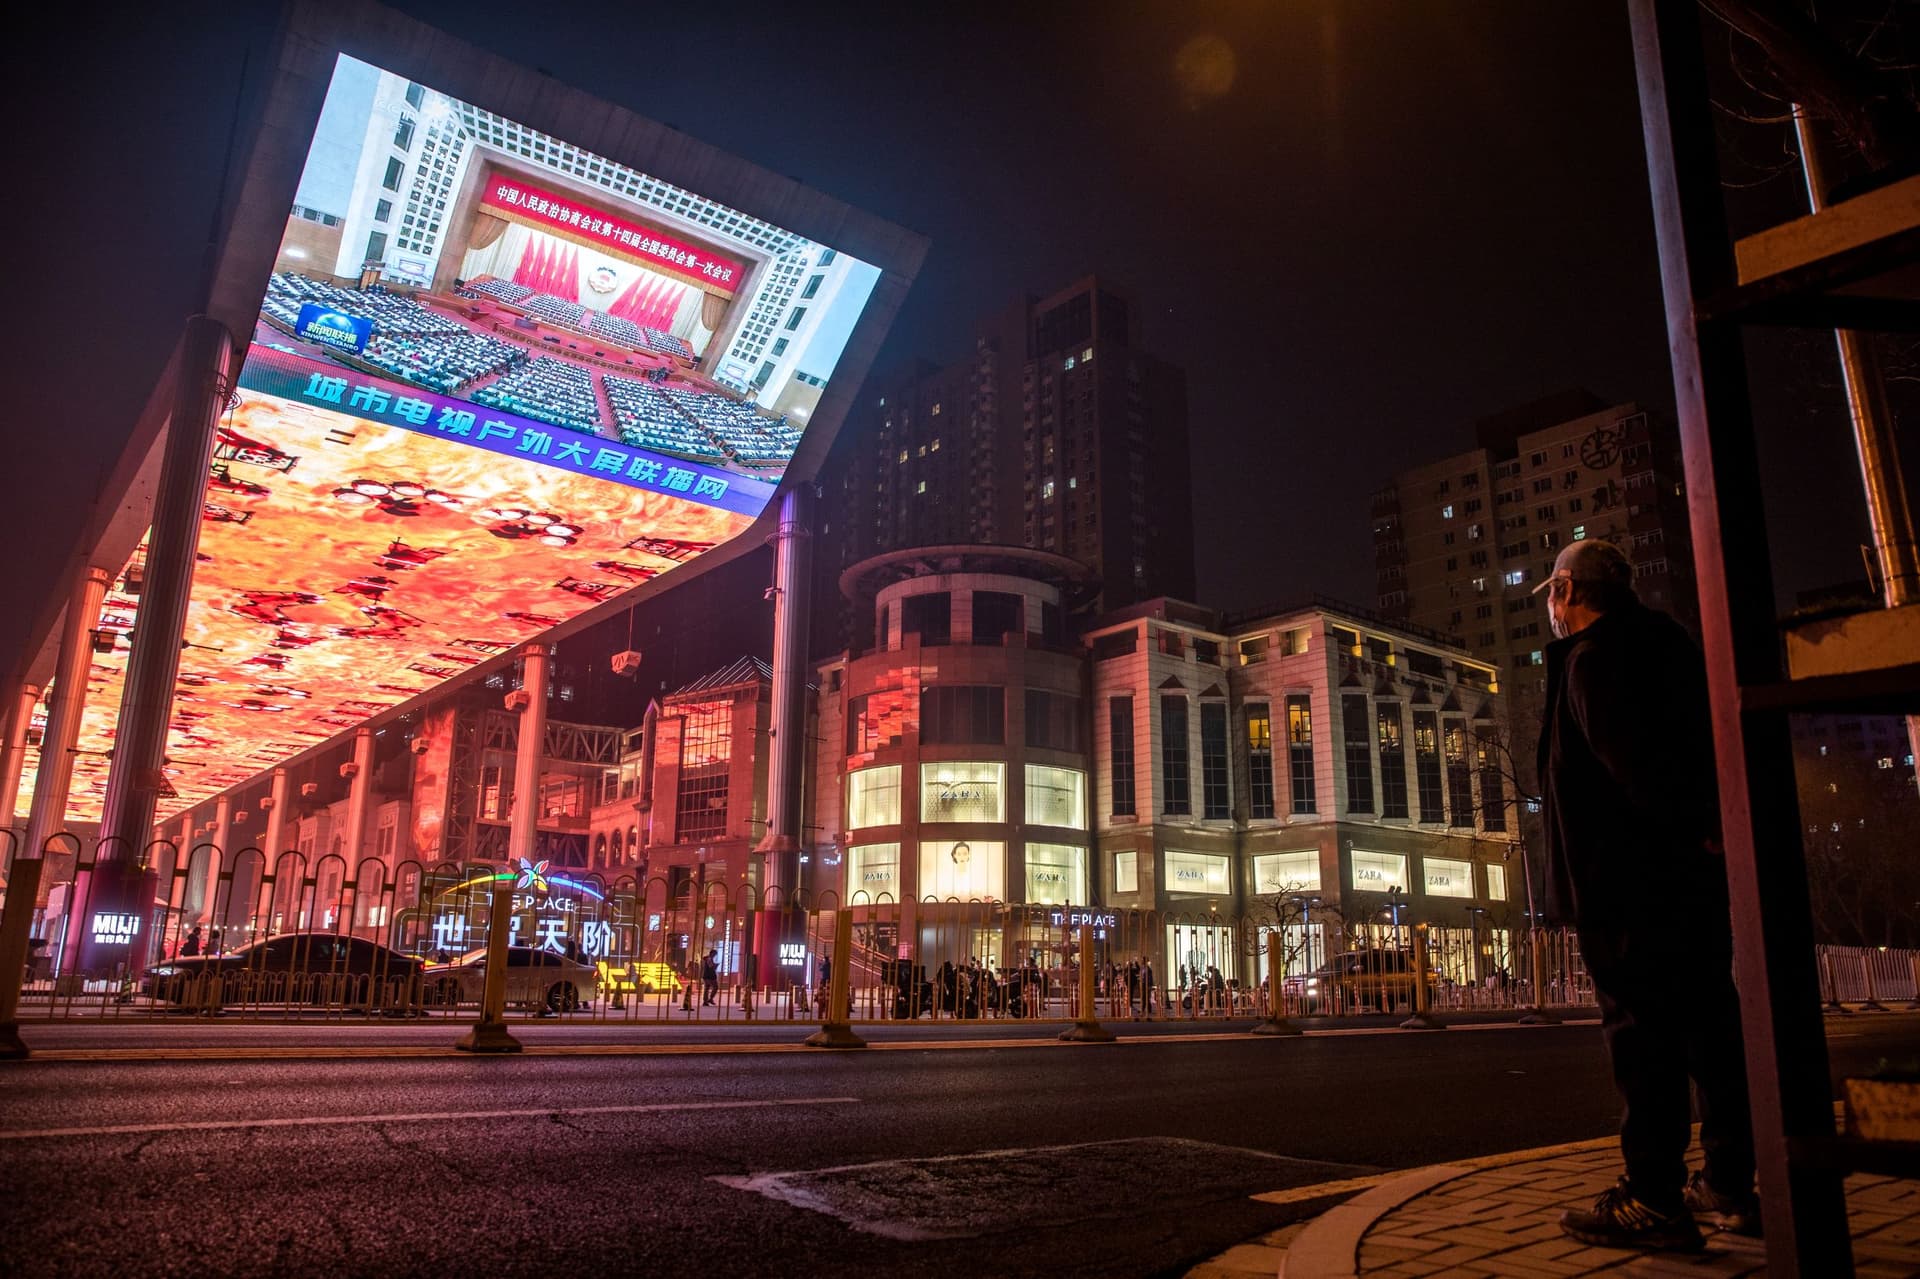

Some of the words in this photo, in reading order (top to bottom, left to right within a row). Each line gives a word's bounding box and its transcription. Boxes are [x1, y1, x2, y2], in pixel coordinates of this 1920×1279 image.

[496, 185, 734, 282] 中国人民政治协商会议第十四届全国委员会第一次会议
[307, 322, 358, 344] 新闻联播
[303, 371, 730, 501] 城市电视户外大屏联播网
[864, 872, 893, 881] ZARA
[1034, 871, 1066, 882] ZARA
[1358, 869, 1382, 881] ZARA
[1428, 876, 1450, 887] ZARA
[486, 893, 520, 910] TE
[93, 915, 140, 934] MUJI
[780, 944, 806, 959] MUJI
